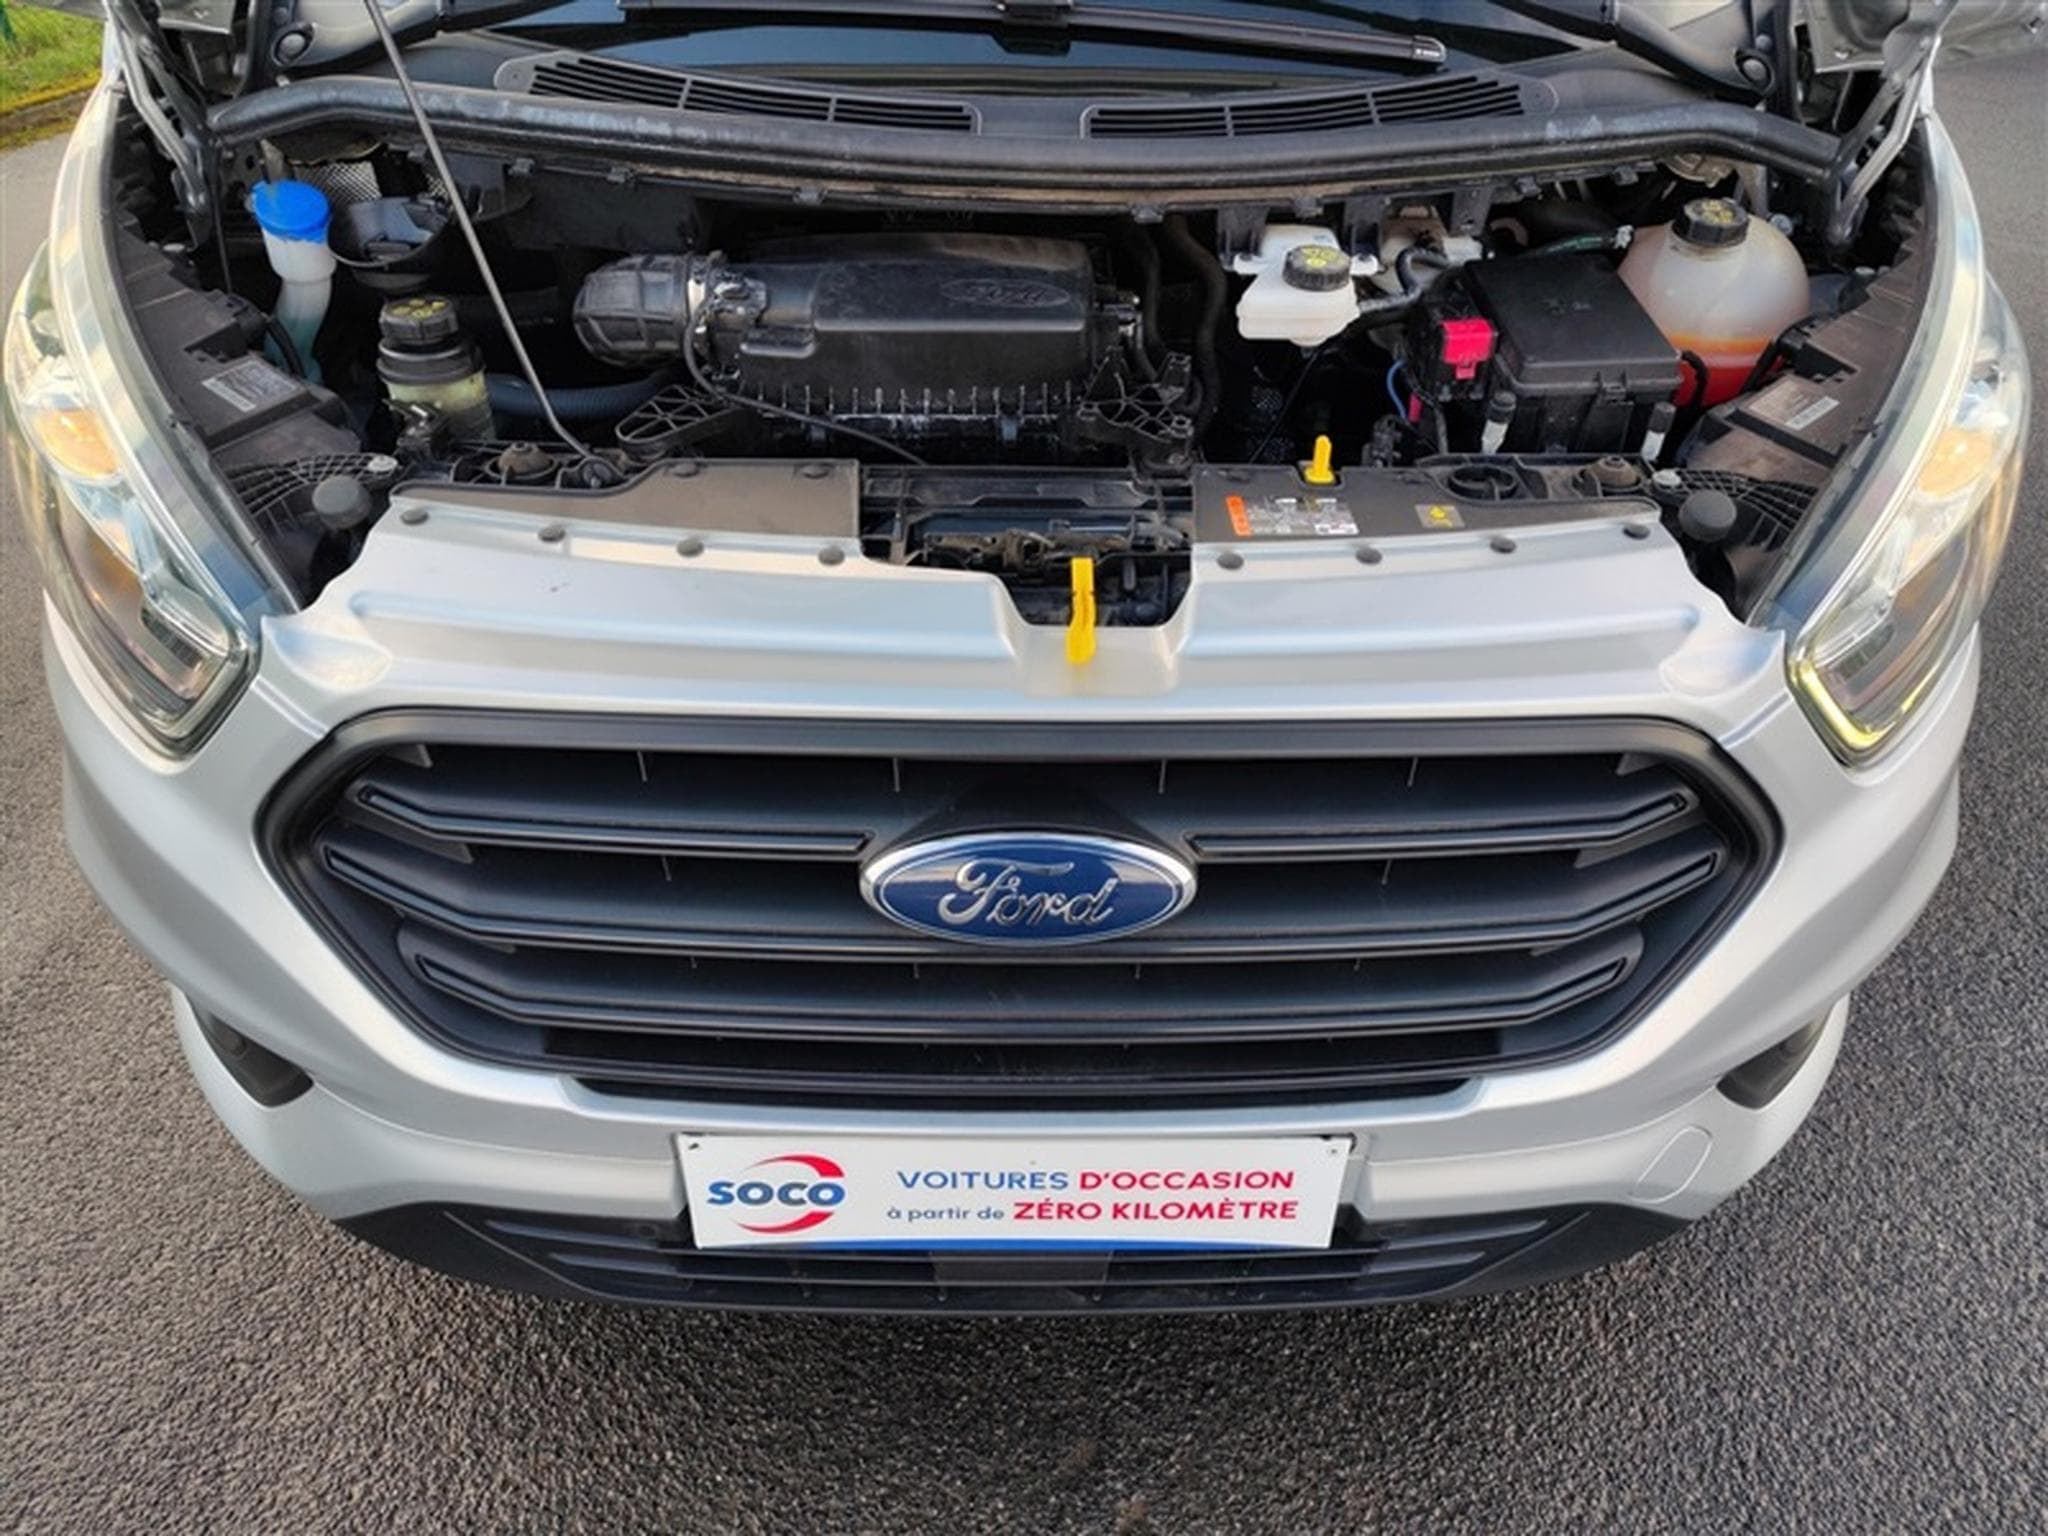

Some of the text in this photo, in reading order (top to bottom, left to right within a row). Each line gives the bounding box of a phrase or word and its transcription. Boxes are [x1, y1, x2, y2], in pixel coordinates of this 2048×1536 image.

[938, 858, 1119, 925] Ford
[707, 1180, 846, 1206] SOCO
[897, 1171, 1294, 1190] VOITURES D'OCCASION
[887, 1197, 1299, 1222] à partir de ZÉRO KILOMÈTRE
